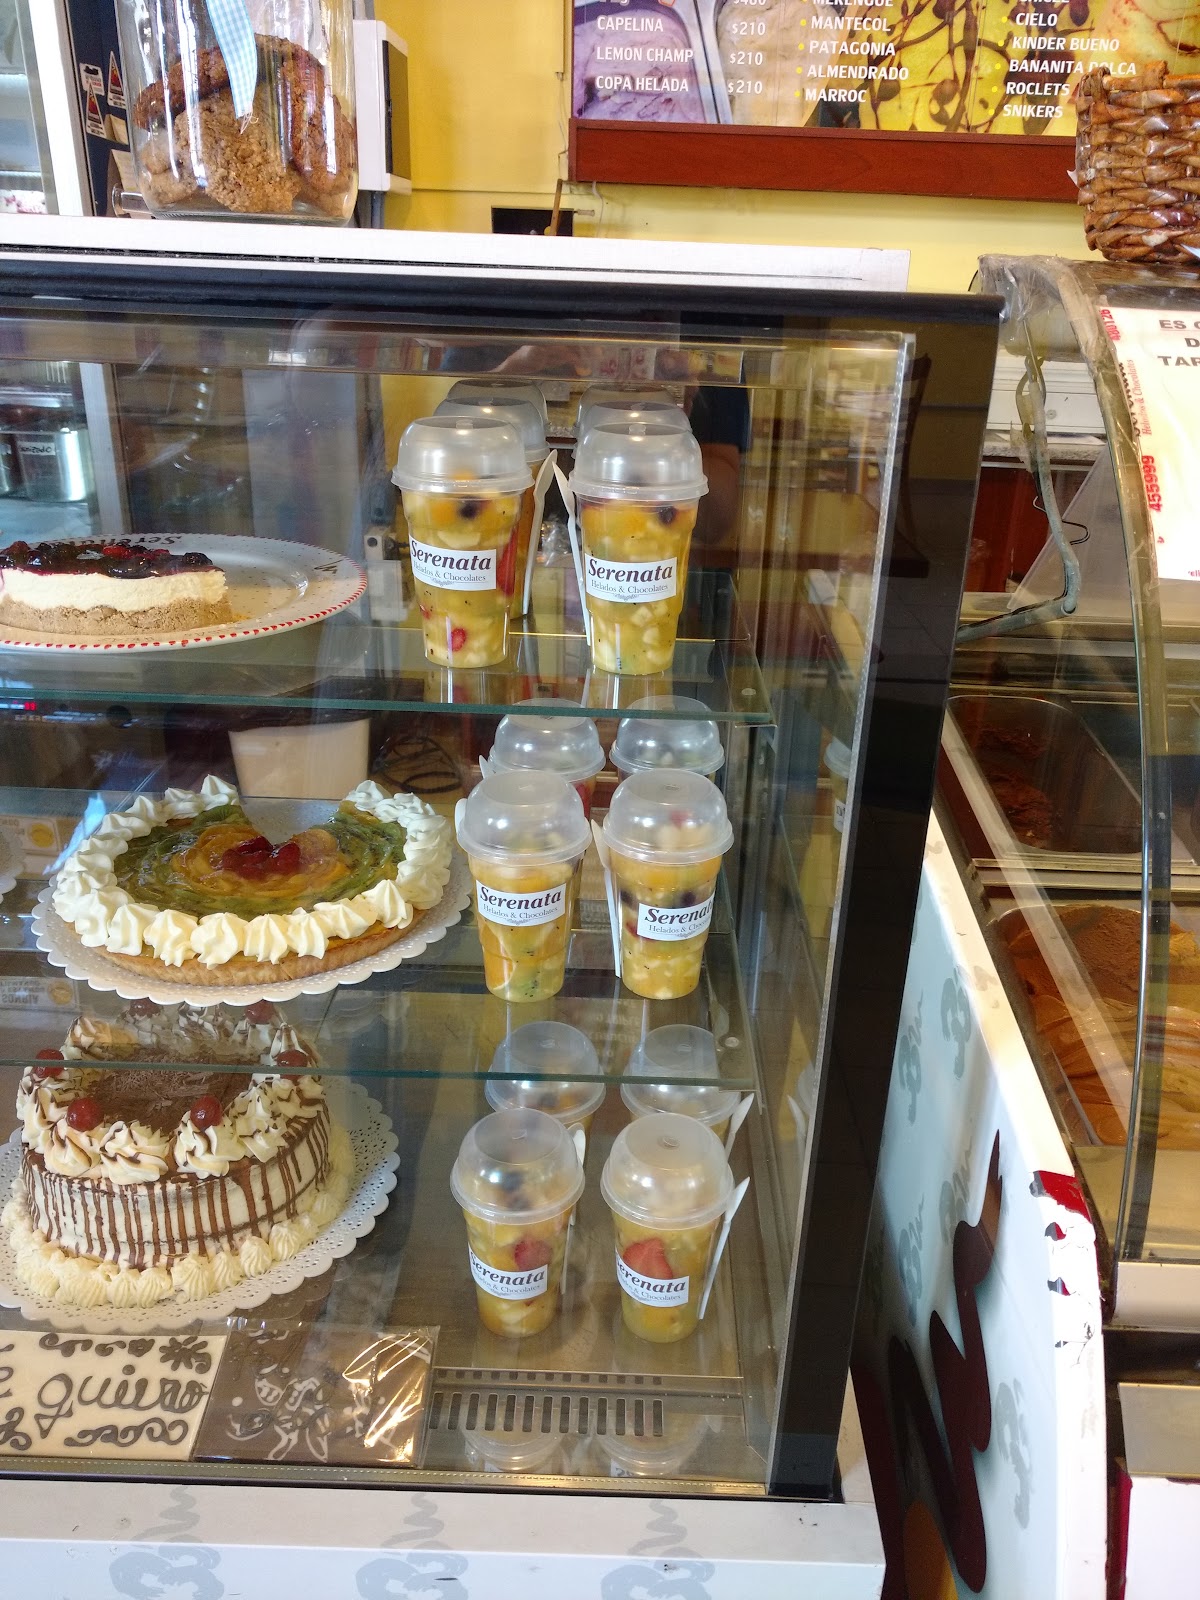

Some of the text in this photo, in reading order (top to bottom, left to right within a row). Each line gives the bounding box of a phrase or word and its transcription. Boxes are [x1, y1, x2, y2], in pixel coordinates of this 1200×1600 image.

[597, 16, 663, 32] CAPELINA
[810, 16, 891, 32] MANTECOL
[1015, 13, 1058, 27] CIELO
[732, 21, 766, 36] $210
[809, 40, 896, 57] PATAGONIA
[1011, 36, 1120, 52] KINDER BUENO
[596, 47, 694, 63] LEMON CHAMP
[730, 51, 763, 66] $210
[807, 64, 909, 81] ALMENDRADO
[1008, 59, 1084, 74] BANANITA
[596, 76, 689, 92] COPA HELADA
[728, 80, 763, 95] $210
[1005, 82, 1070, 97] ROCLETS
[805, 88, 867, 103] MARROC
[1002, 104, 1063, 119] SNIKERS
[1159, 319, 1187, 330] ES
[1141, 455, 1162, 513] 455999
[411, 540, 492, 571] Serenata
[443, 572, 486, 582] Chocolates
[588, 558, 673, 583] Serenata
[591, 579, 616, 592] Helados
[627, 584, 669, 594] Chocolates
[480, 886, 562, 910] Serenata
[483, 904, 509, 918] Helados
[519, 907, 558, 919] Chocolates
[644, 900, 713, 925] Serenat
[649, 924, 680, 934] Helados
[641, 1290, 681, 1301] Chocolates
